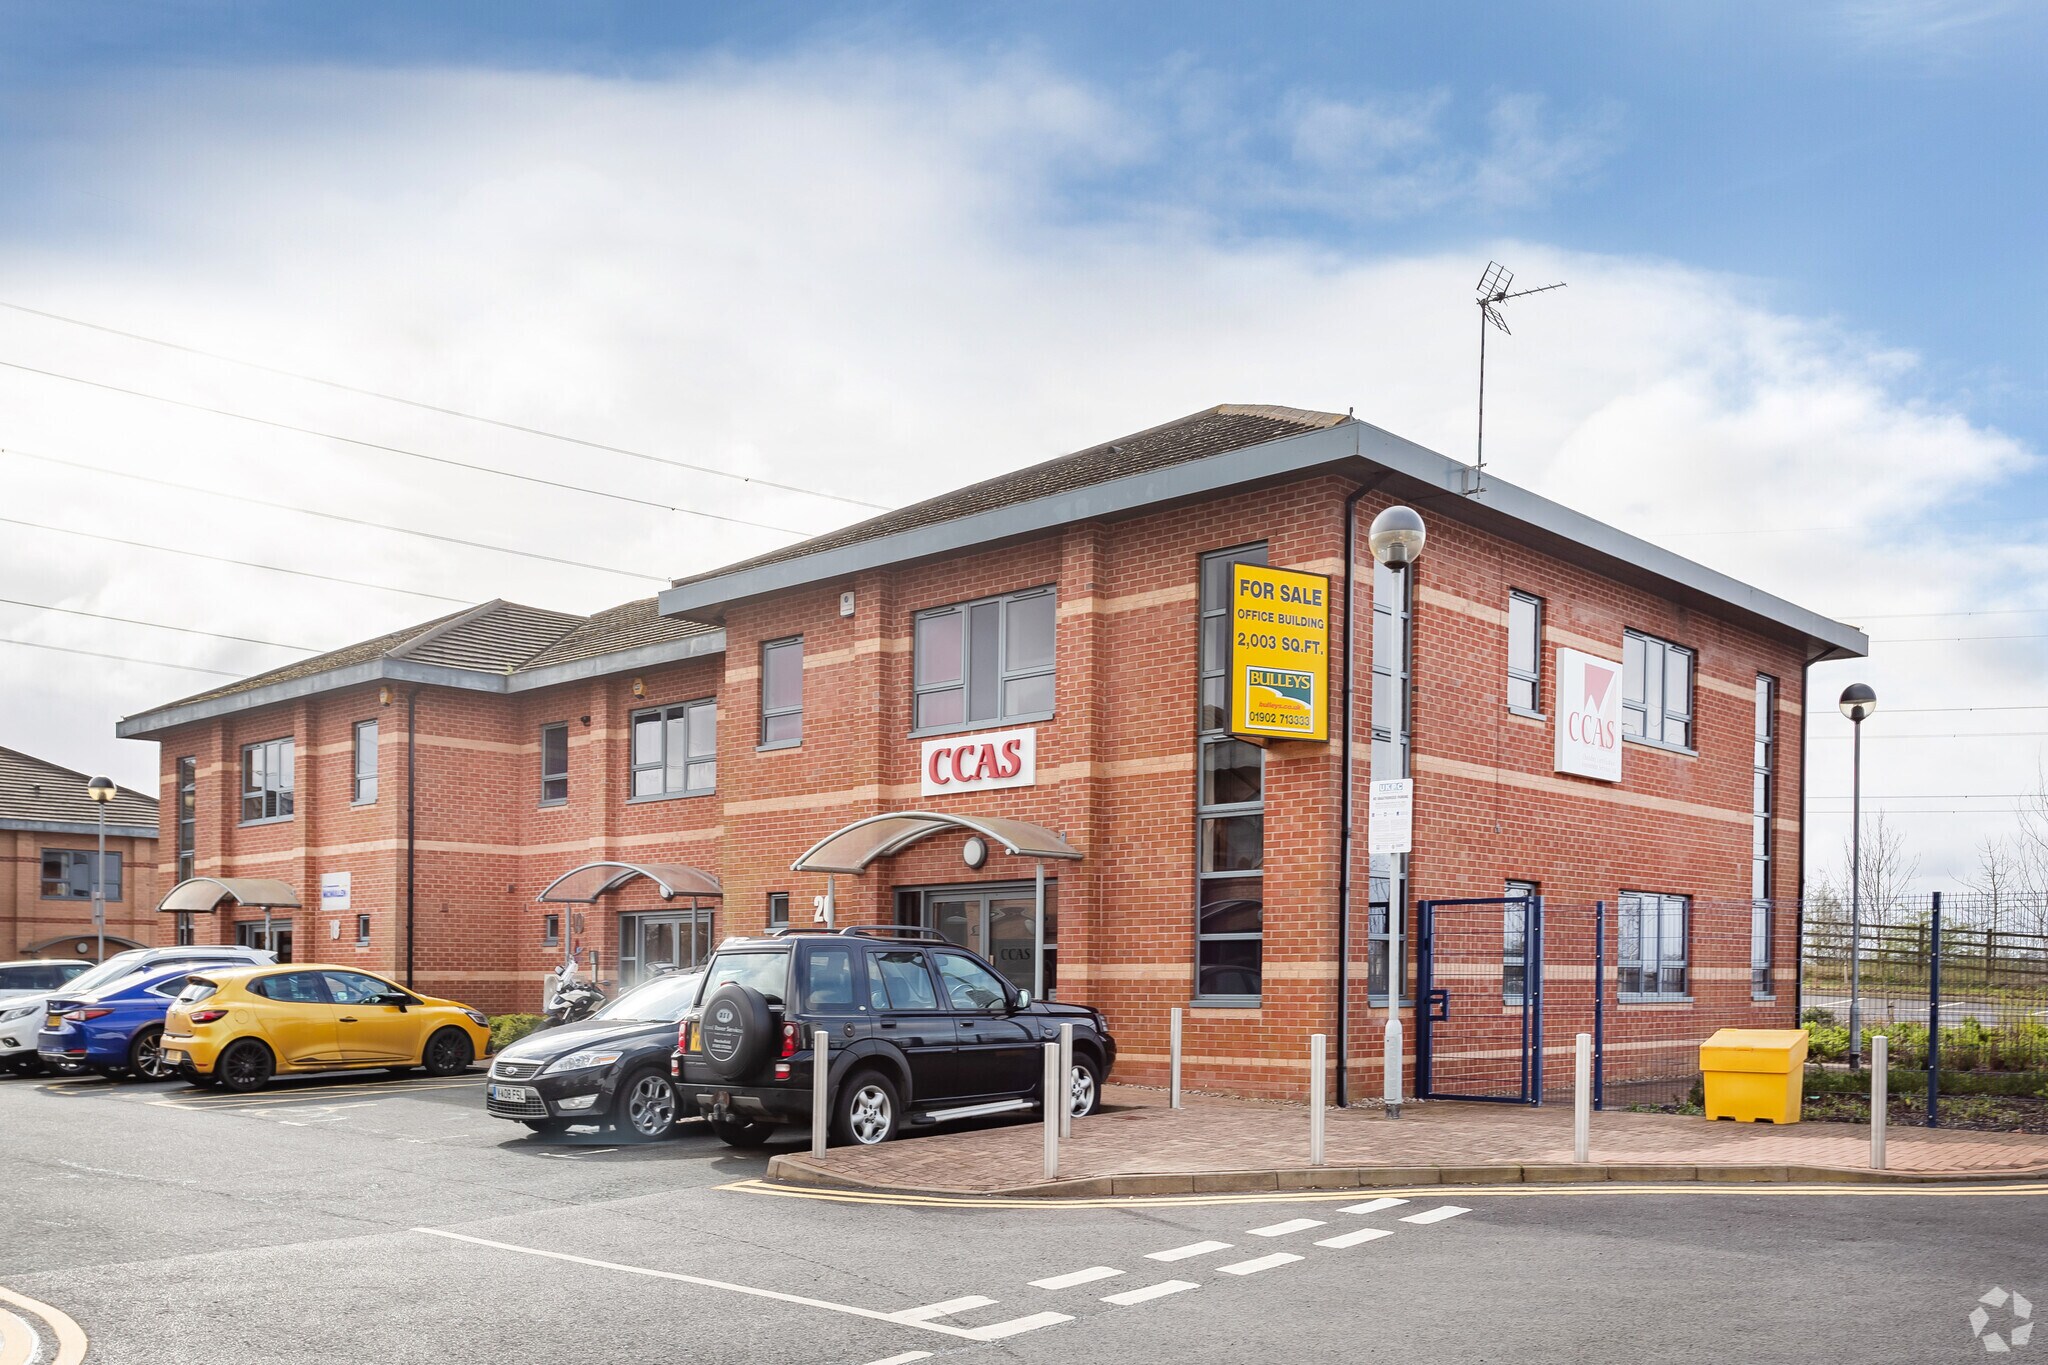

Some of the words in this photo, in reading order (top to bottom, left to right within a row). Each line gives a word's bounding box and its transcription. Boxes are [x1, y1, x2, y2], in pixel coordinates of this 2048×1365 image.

[1240, 579, 1274, 600] FOR
[1280, 584, 1322, 607] SALE
[1237, 608, 1274, 623] OFFICE
[1278, 613, 1324, 629] BUILDING
[1237, 632, 1276, 650] 2,003
[1281, 637, 1324, 655] SQ.FT.
[1250, 671, 1311, 689] BULLEYS
[1249, 711, 1276, 723] 01902
[1280, 714, 1311, 726] 713333
[1569, 711, 1615, 749] CCAS
[928, 739, 1022, 785] CCAS
[1379, 783, 1403, 792] UKPC
[1000, 948, 1031, 961] CCAS
